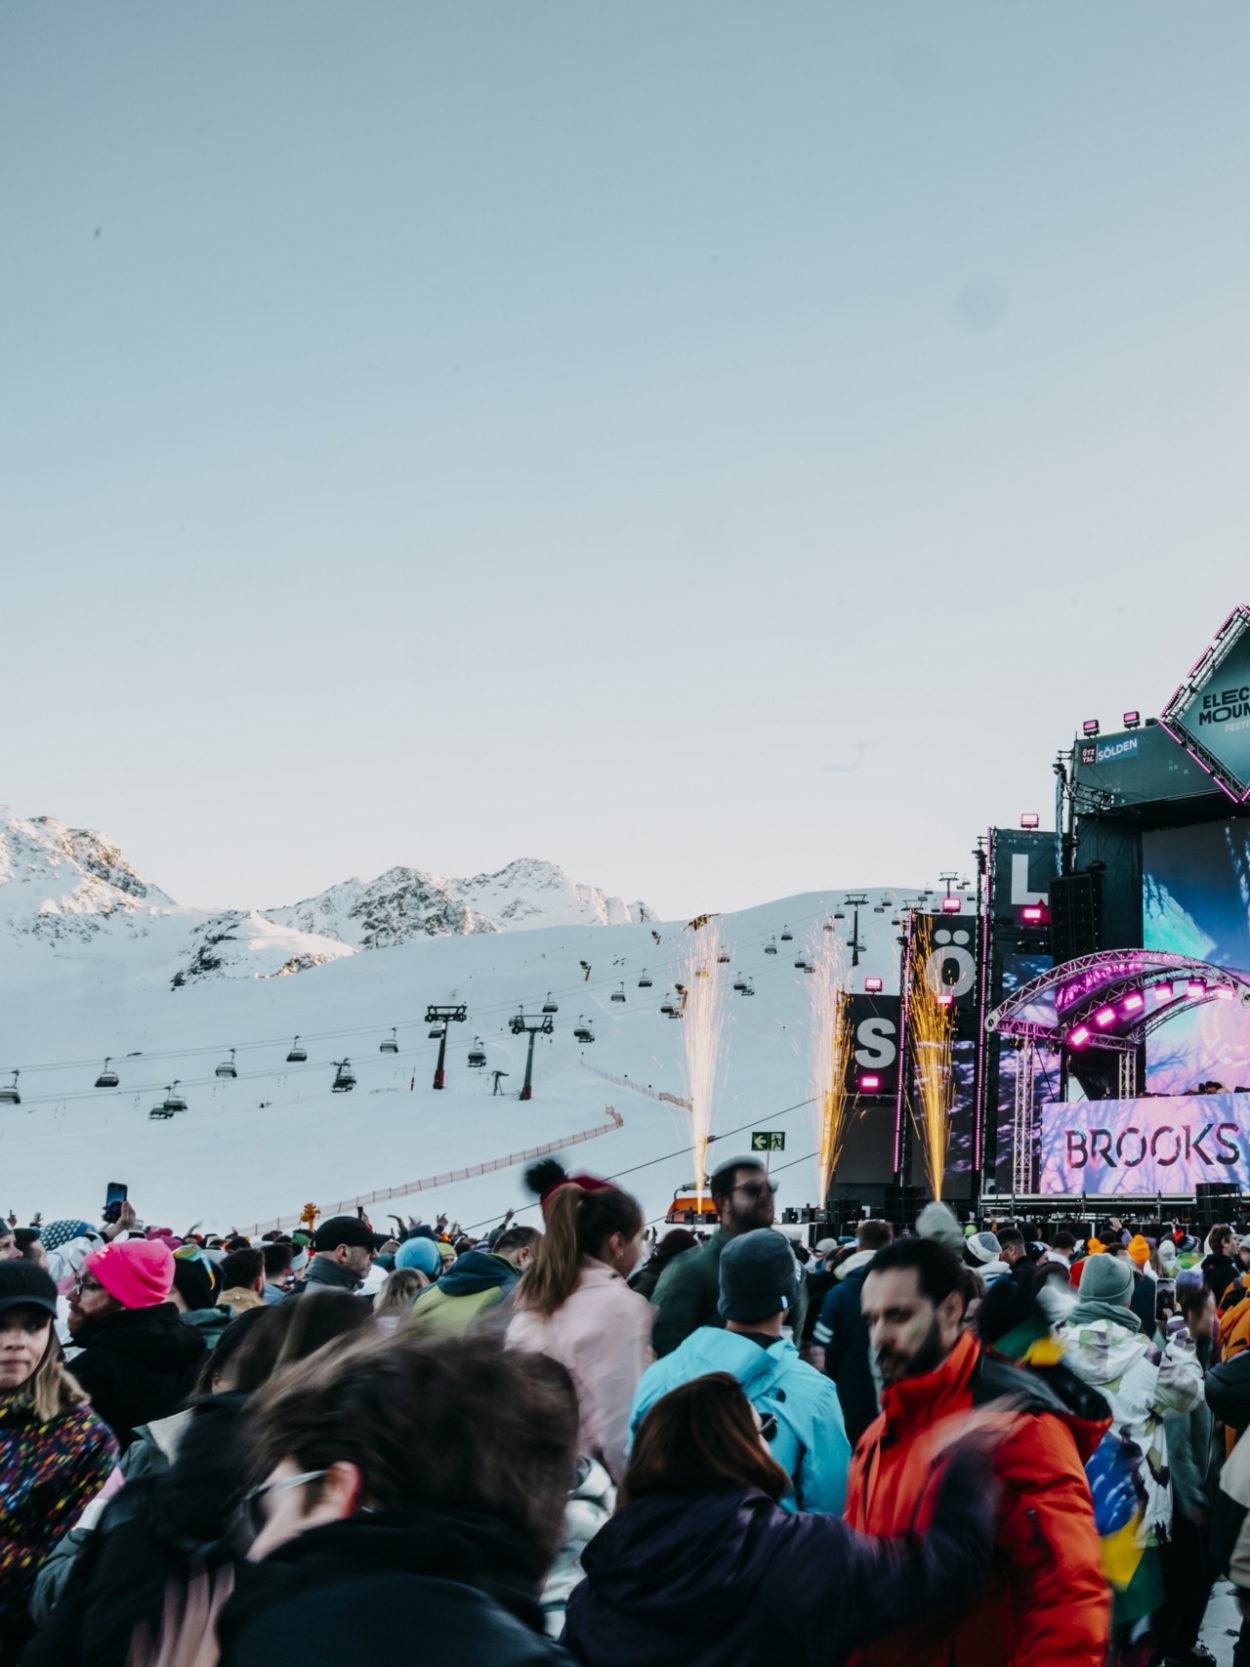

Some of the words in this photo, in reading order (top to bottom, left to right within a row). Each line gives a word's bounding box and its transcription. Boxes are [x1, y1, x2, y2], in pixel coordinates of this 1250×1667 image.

[1098, 738, 1138, 761] SÖLDEN
[1011, 853, 1049, 906] L
[854, 1017, 896, 1069] S
[1064, 1122, 1241, 1169] BROOKS
